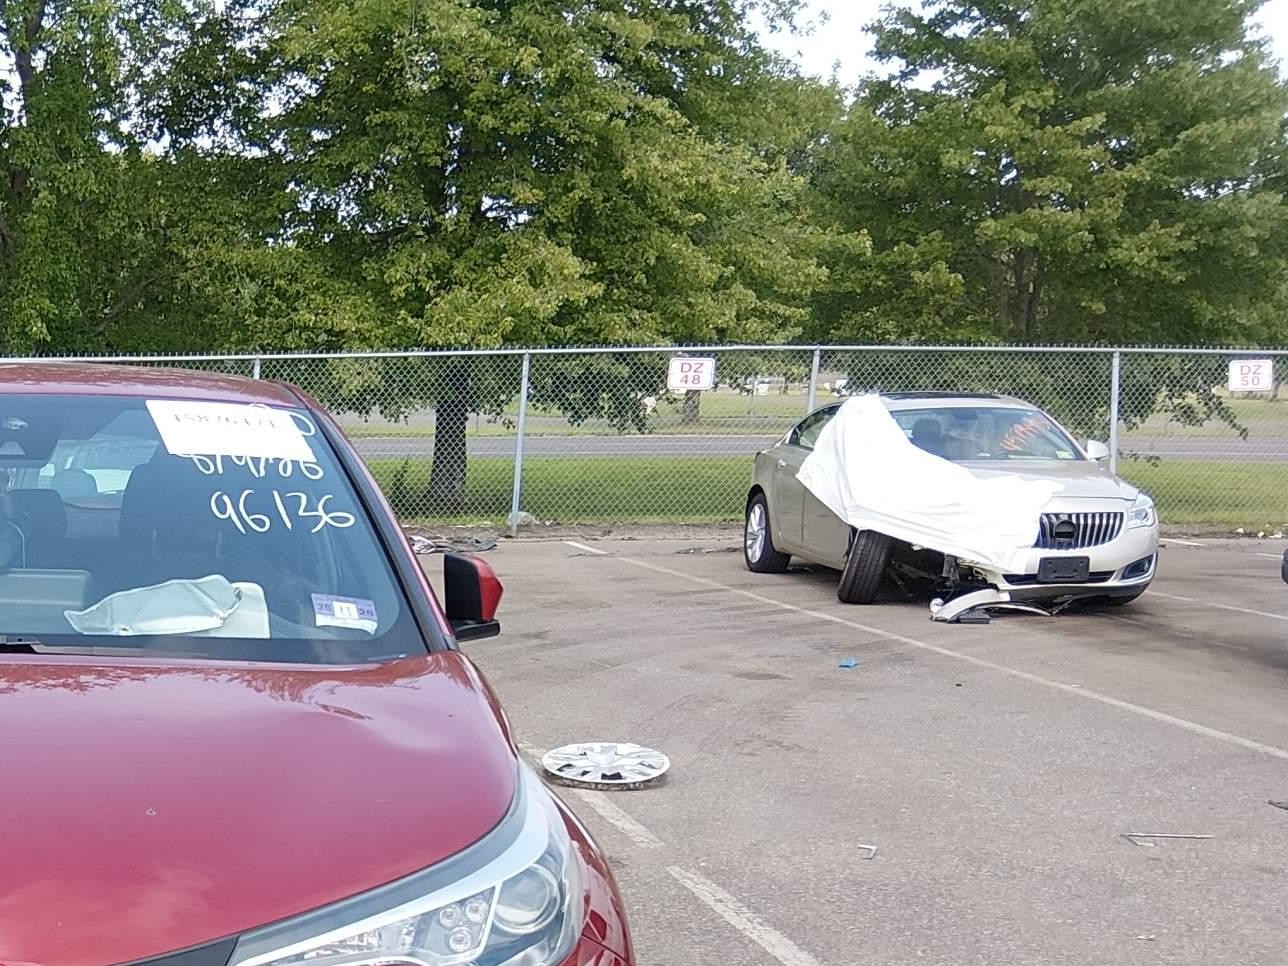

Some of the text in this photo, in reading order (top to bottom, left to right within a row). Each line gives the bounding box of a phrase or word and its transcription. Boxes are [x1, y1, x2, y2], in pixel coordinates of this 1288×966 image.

[680, 362, 704, 373] DZ
[1240, 364, 1263, 376] DZ
[679, 374, 701, 385] 48
[1240, 375, 1260, 386] 50
[210, 489, 355, 535] 96136
